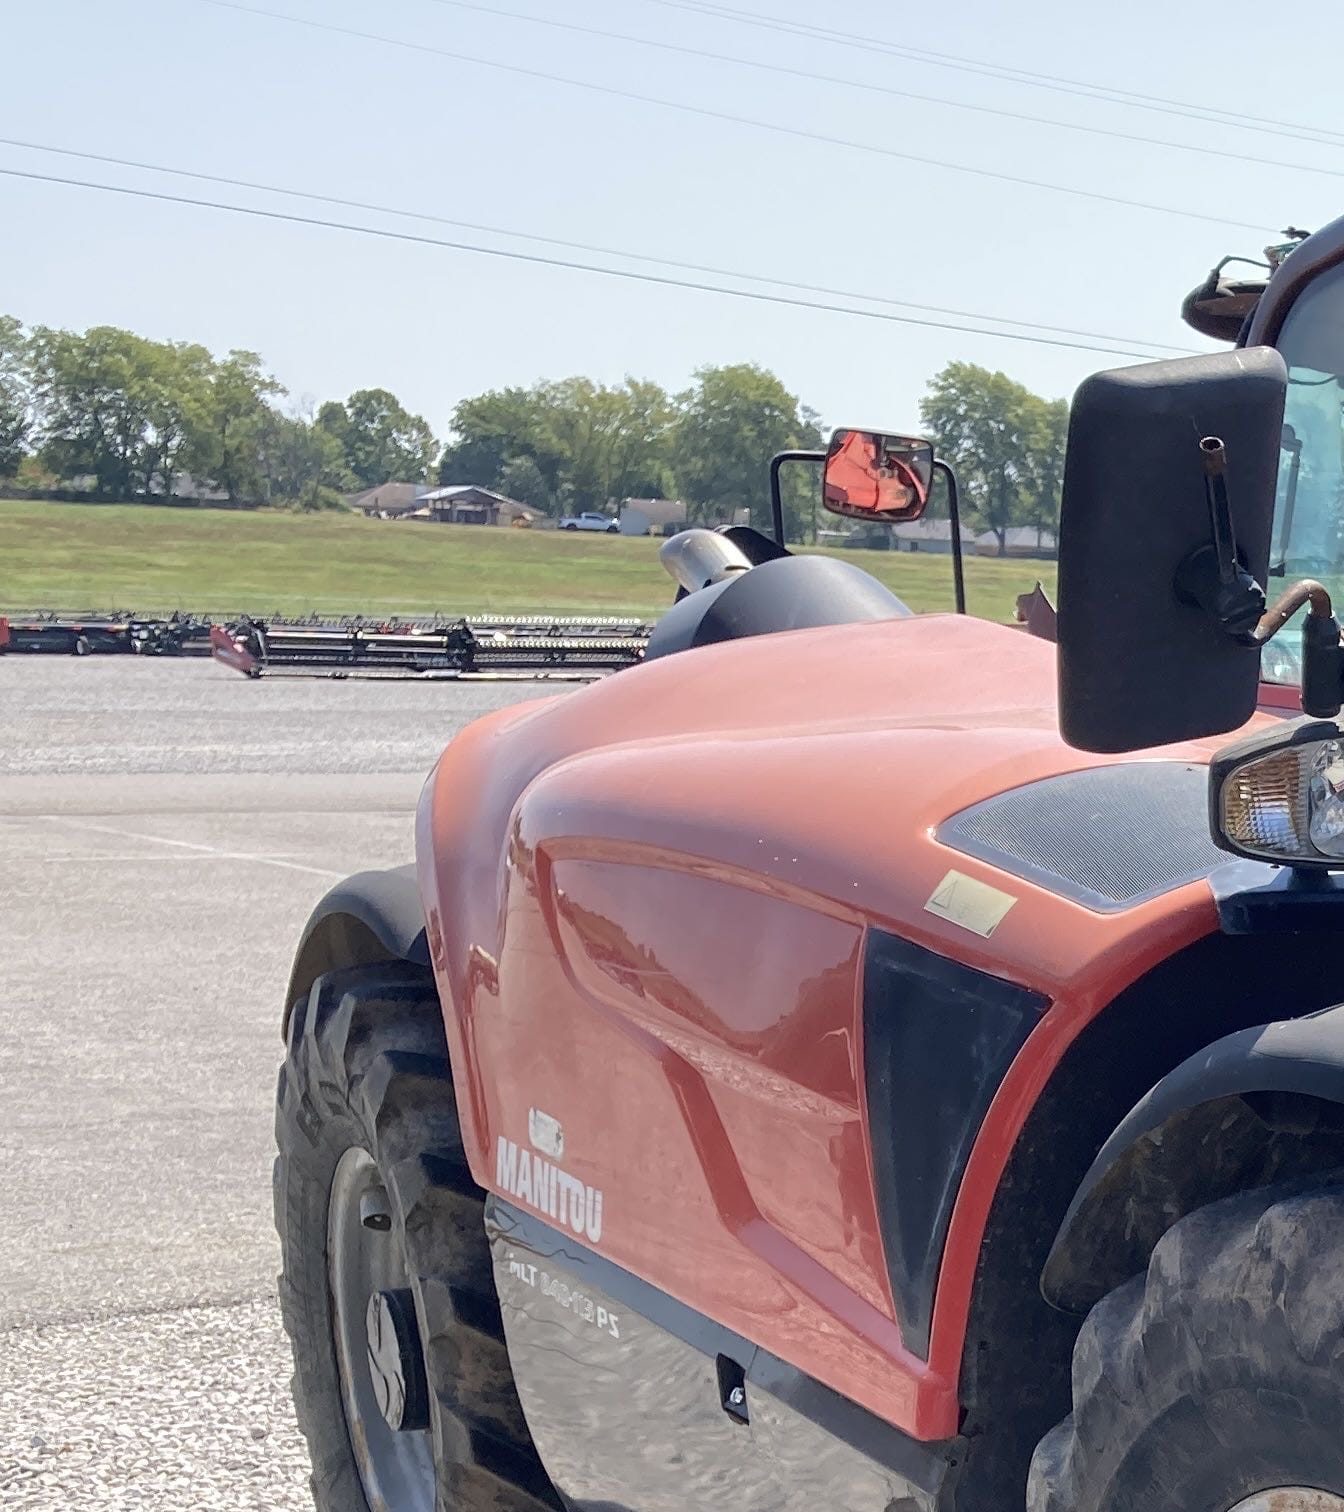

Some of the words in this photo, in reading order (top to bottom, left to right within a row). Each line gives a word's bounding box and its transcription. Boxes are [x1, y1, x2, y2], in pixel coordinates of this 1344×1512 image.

[497, 1136, 603, 1243] MANITOU
[508, 1259, 538, 1287] MLT
[597, 1305, 619, 1338] PS
